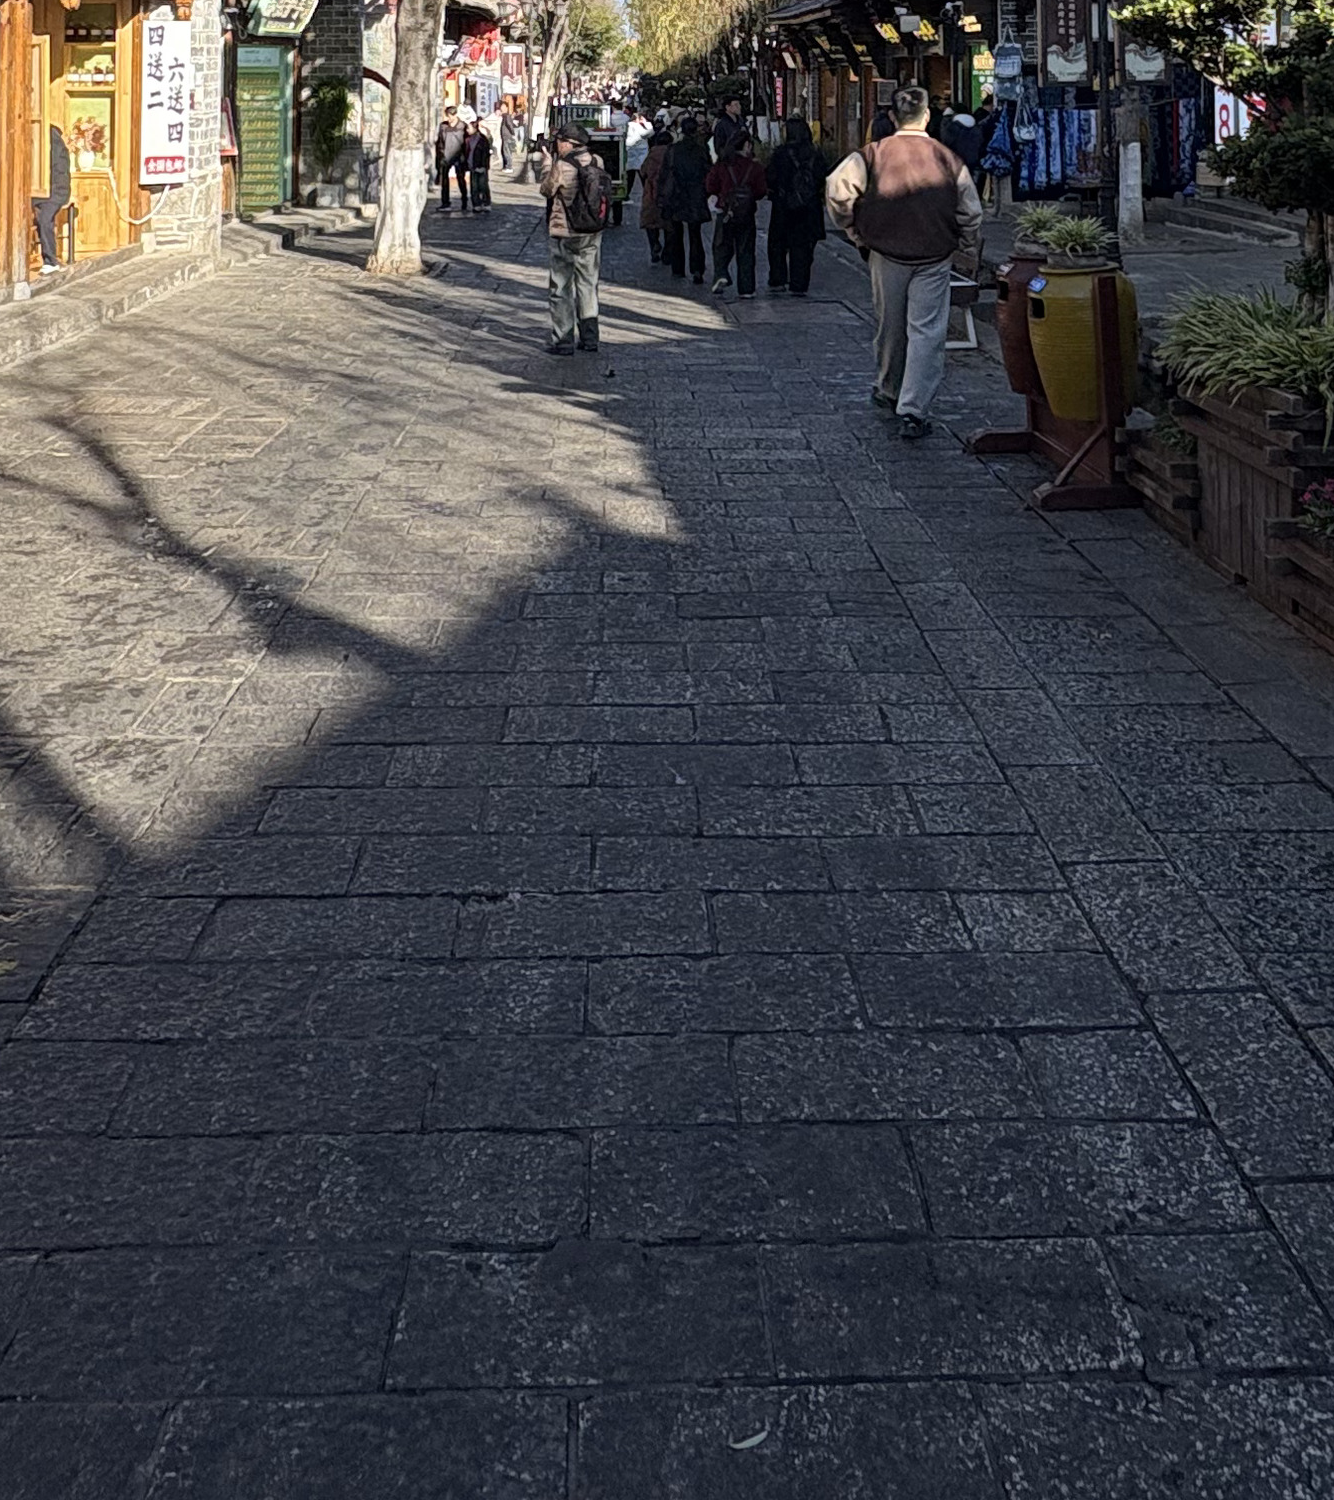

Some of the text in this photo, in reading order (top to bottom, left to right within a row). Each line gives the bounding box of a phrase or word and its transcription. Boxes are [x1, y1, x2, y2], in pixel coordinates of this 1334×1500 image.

[147, 25, 165, 110] 四送二
[167, 57, 185, 143] 六送四
